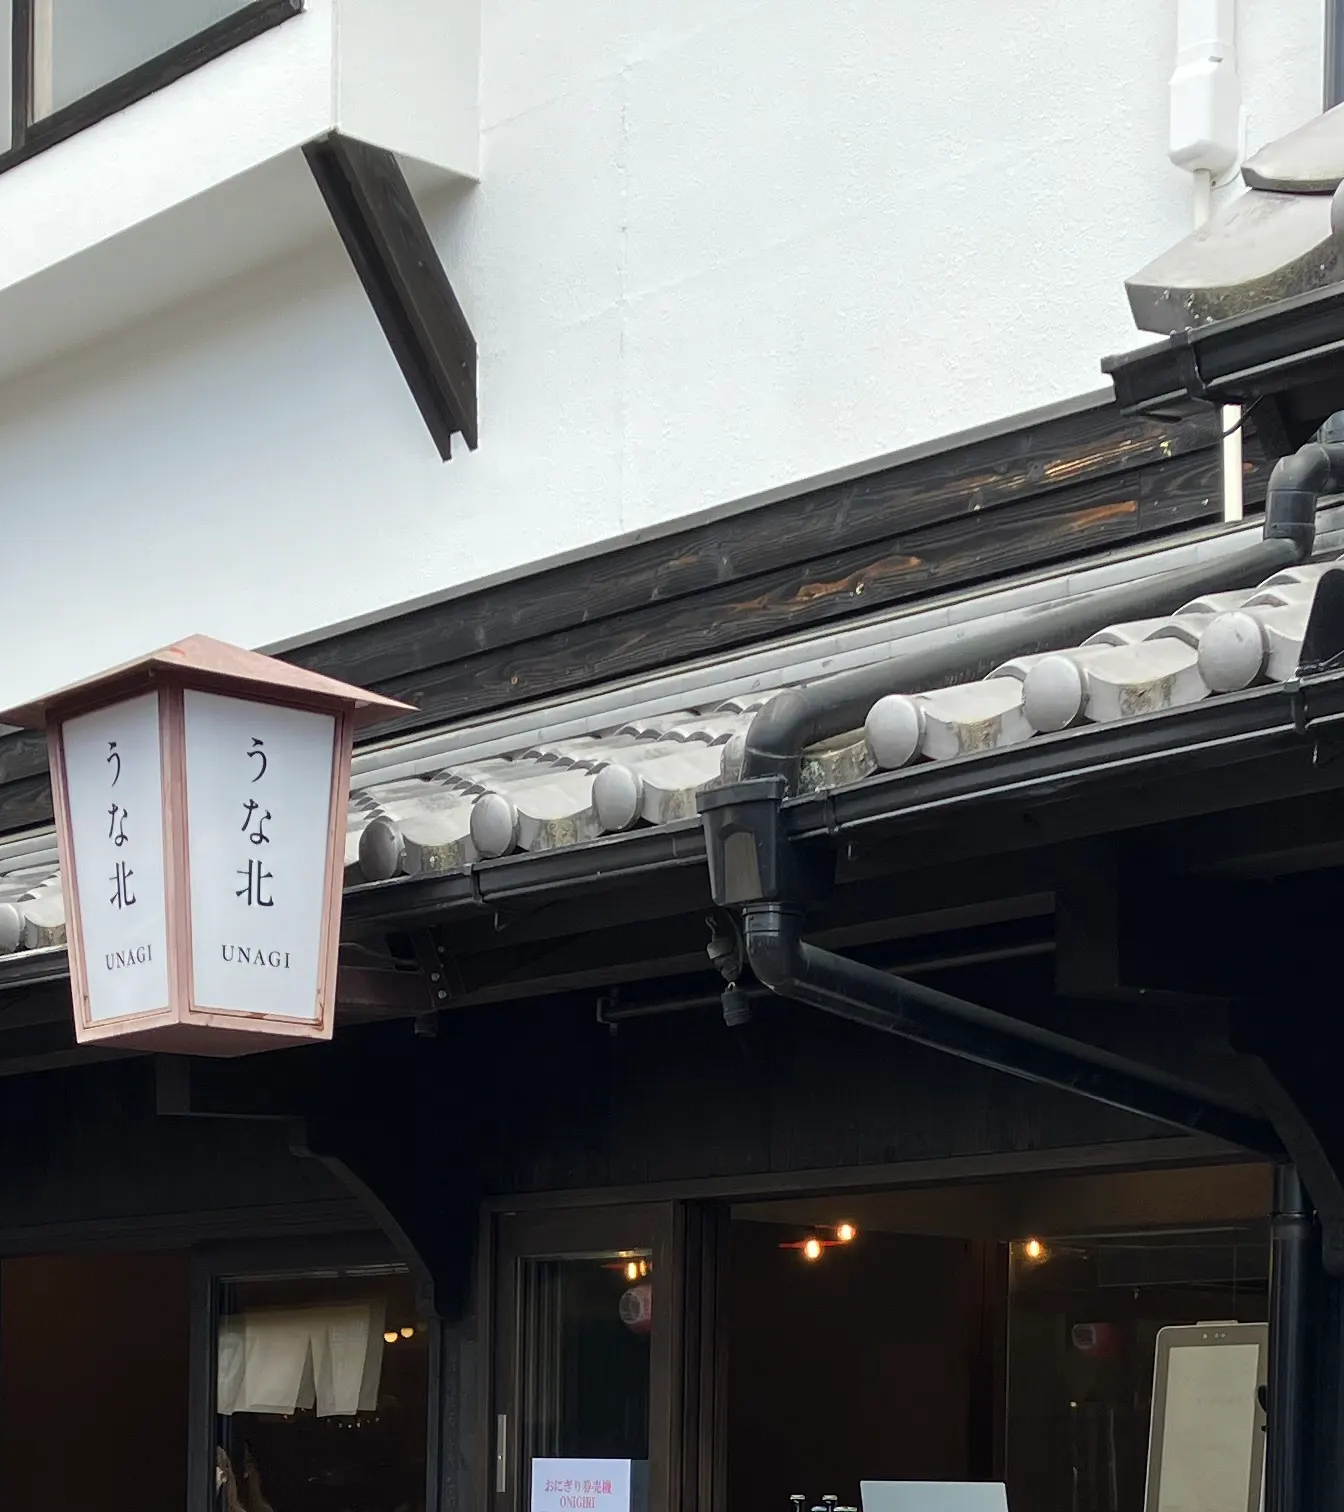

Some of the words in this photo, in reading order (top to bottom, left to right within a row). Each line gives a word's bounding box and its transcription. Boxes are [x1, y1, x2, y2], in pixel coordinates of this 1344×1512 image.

[106, 740, 137, 910] うな北
[235, 736, 274, 908] うな北
[105, 944, 153, 971] UNAGI
[221, 943, 291, 970] UNAGI
[544, 1479, 612, 1495] おにぎり券売機
[559, 1495, 596, 1509] ONIGIRI
